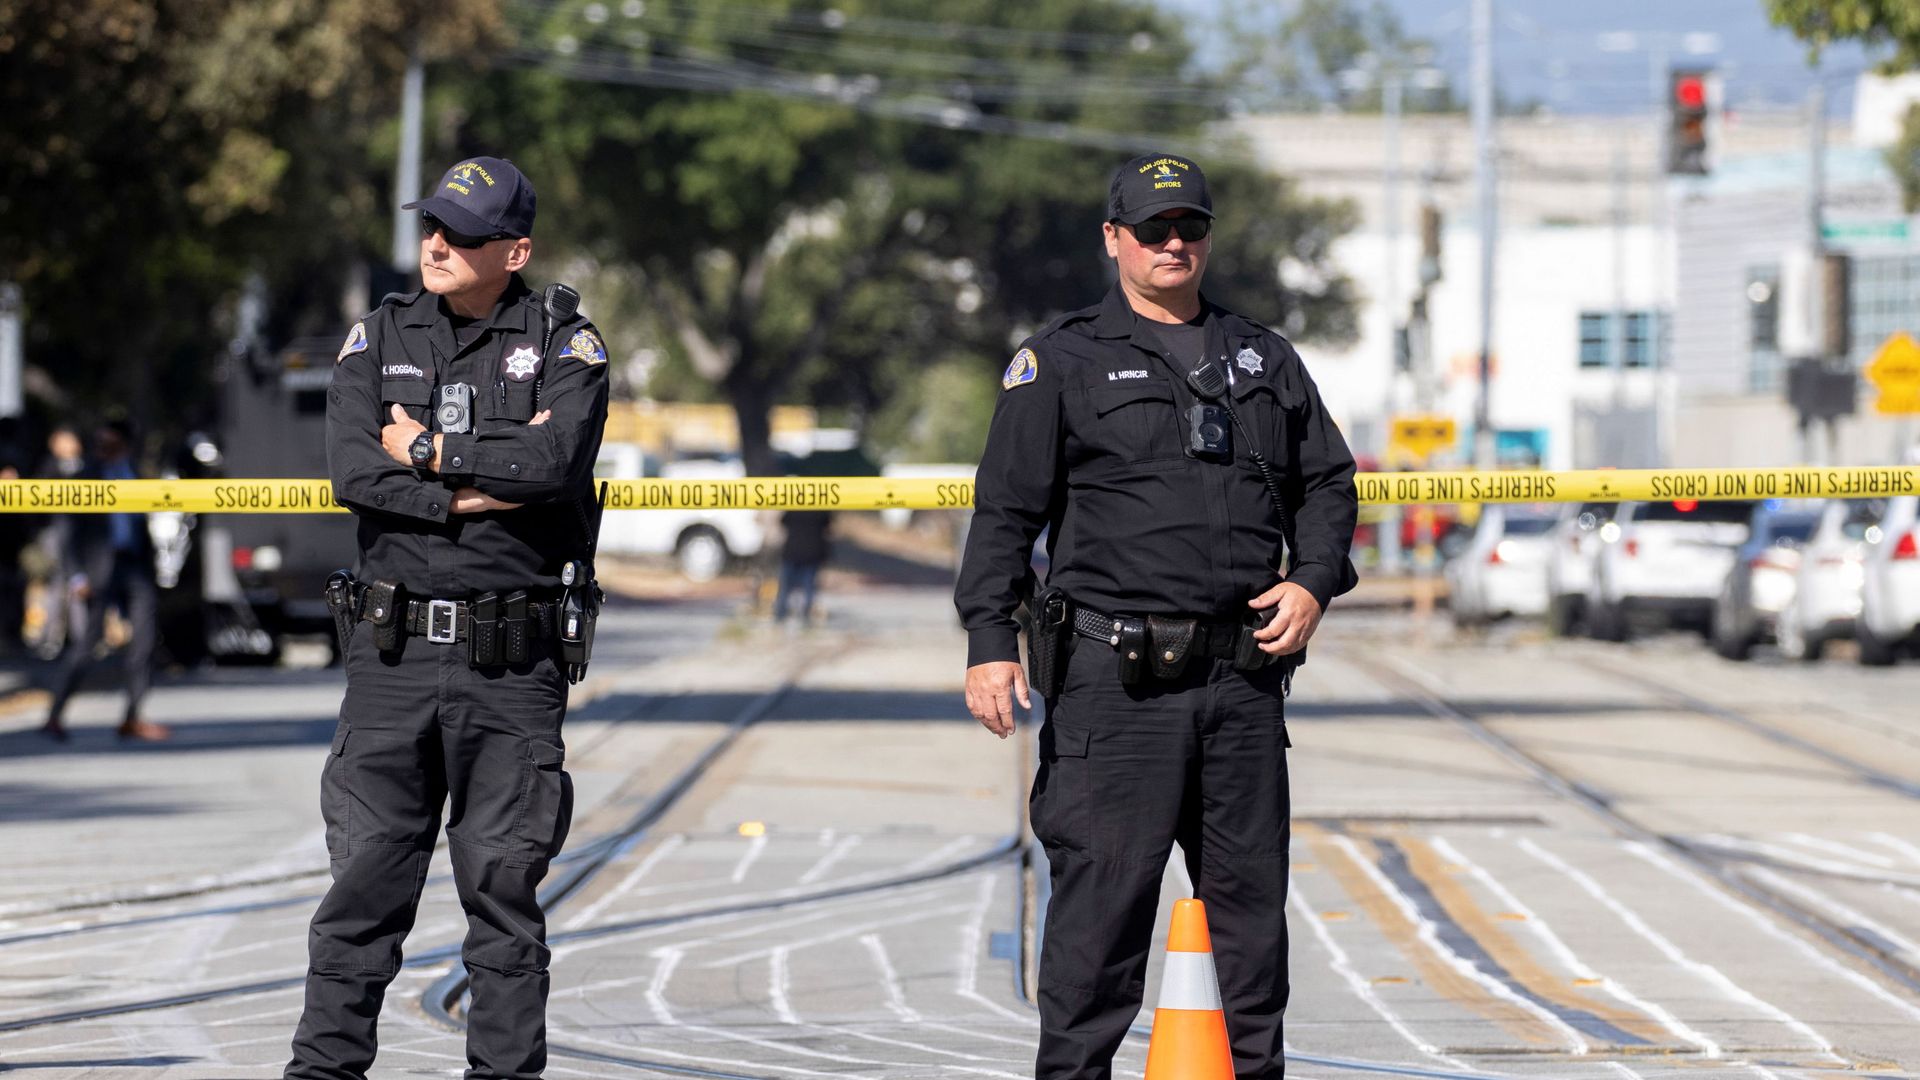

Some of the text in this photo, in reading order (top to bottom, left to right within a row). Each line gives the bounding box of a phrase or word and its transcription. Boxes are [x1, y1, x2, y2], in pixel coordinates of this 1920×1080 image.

[476, 167, 495, 187] POLICE
[1139, 163, 1152, 174] SAN
[1168, 159, 1189, 171] POLICE
[447, 182, 470, 195] MOTORS
[1155, 181, 1181, 190] MOTORS
[1108, 369, 1149, 381] M. HRNCIR
[0, 484, 118, 507] SHERIFF'S LIN
[640, 484, 673, 507] NOT
[681, 484, 703, 507] DO
[710, 484, 748, 507] LINE
[755, 483, 840, 506] SHERIFF'S
[937, 476, 1556, 507] SHERIFF'S LINE DO NOT OSS
[1651, 471, 1914, 498] SHERIFF'S LINE DO NOT CROSS
[214, 485, 339, 508] O NOT CROSS
